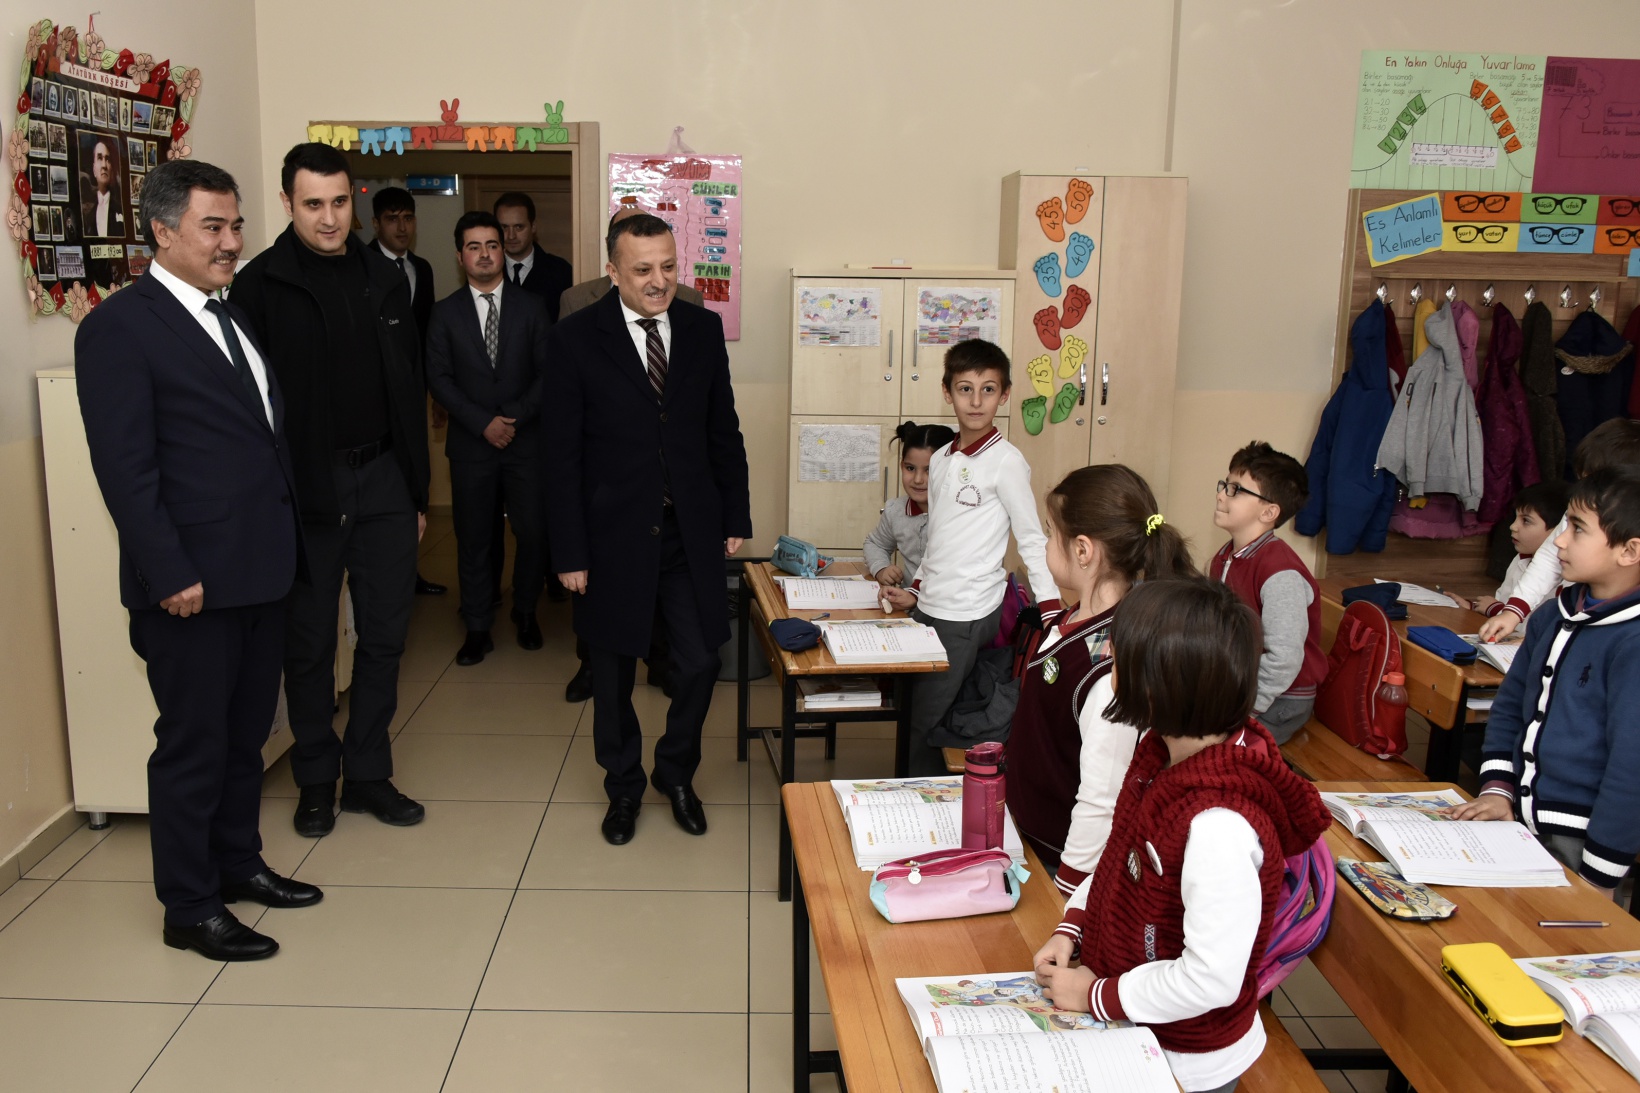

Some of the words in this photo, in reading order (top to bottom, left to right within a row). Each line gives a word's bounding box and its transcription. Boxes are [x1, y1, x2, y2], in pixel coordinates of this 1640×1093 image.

[1385, 56, 1397, 68] En
[1404, 56, 1427, 68] Yakın
[1434, 55, 1467, 74] Onluğa
[1480, 55, 1536, 70] Yuvarlama
[68, 66, 97, 80] ATATÜRK
[100, 75, 128, 88] KÖŞESİ
[1474, 83, 1484, 94] 5
[1414, 100, 1424, 112] 4
[1485, 96, 1495, 106] 6
[1402, 112, 1413, 122] 3
[1496, 110, 1506, 118] 7
[546, 130, 566, 142] 20
[1502, 124, 1511, 134] 8
[692, 182, 738, 196] GÜNLER
[1070, 190, 1086, 212] 50
[1044, 210, 1060, 230] 45
[1394, 198, 1438, 226] Anlamlı
[1072, 244, 1086, 266] 40
[694, 264, 730, 276] TARİH
[1041, 266, 1056, 284] 35
[1068, 296, 1082, 318] 30
[1040, 320, 1056, 338] 25
[1064, 346, 1080, 369] 20
[1034, 370, 1050, 384] 15
[1058, 396, 1072, 414] 10
[1026, 410, 1040, 418] 5
